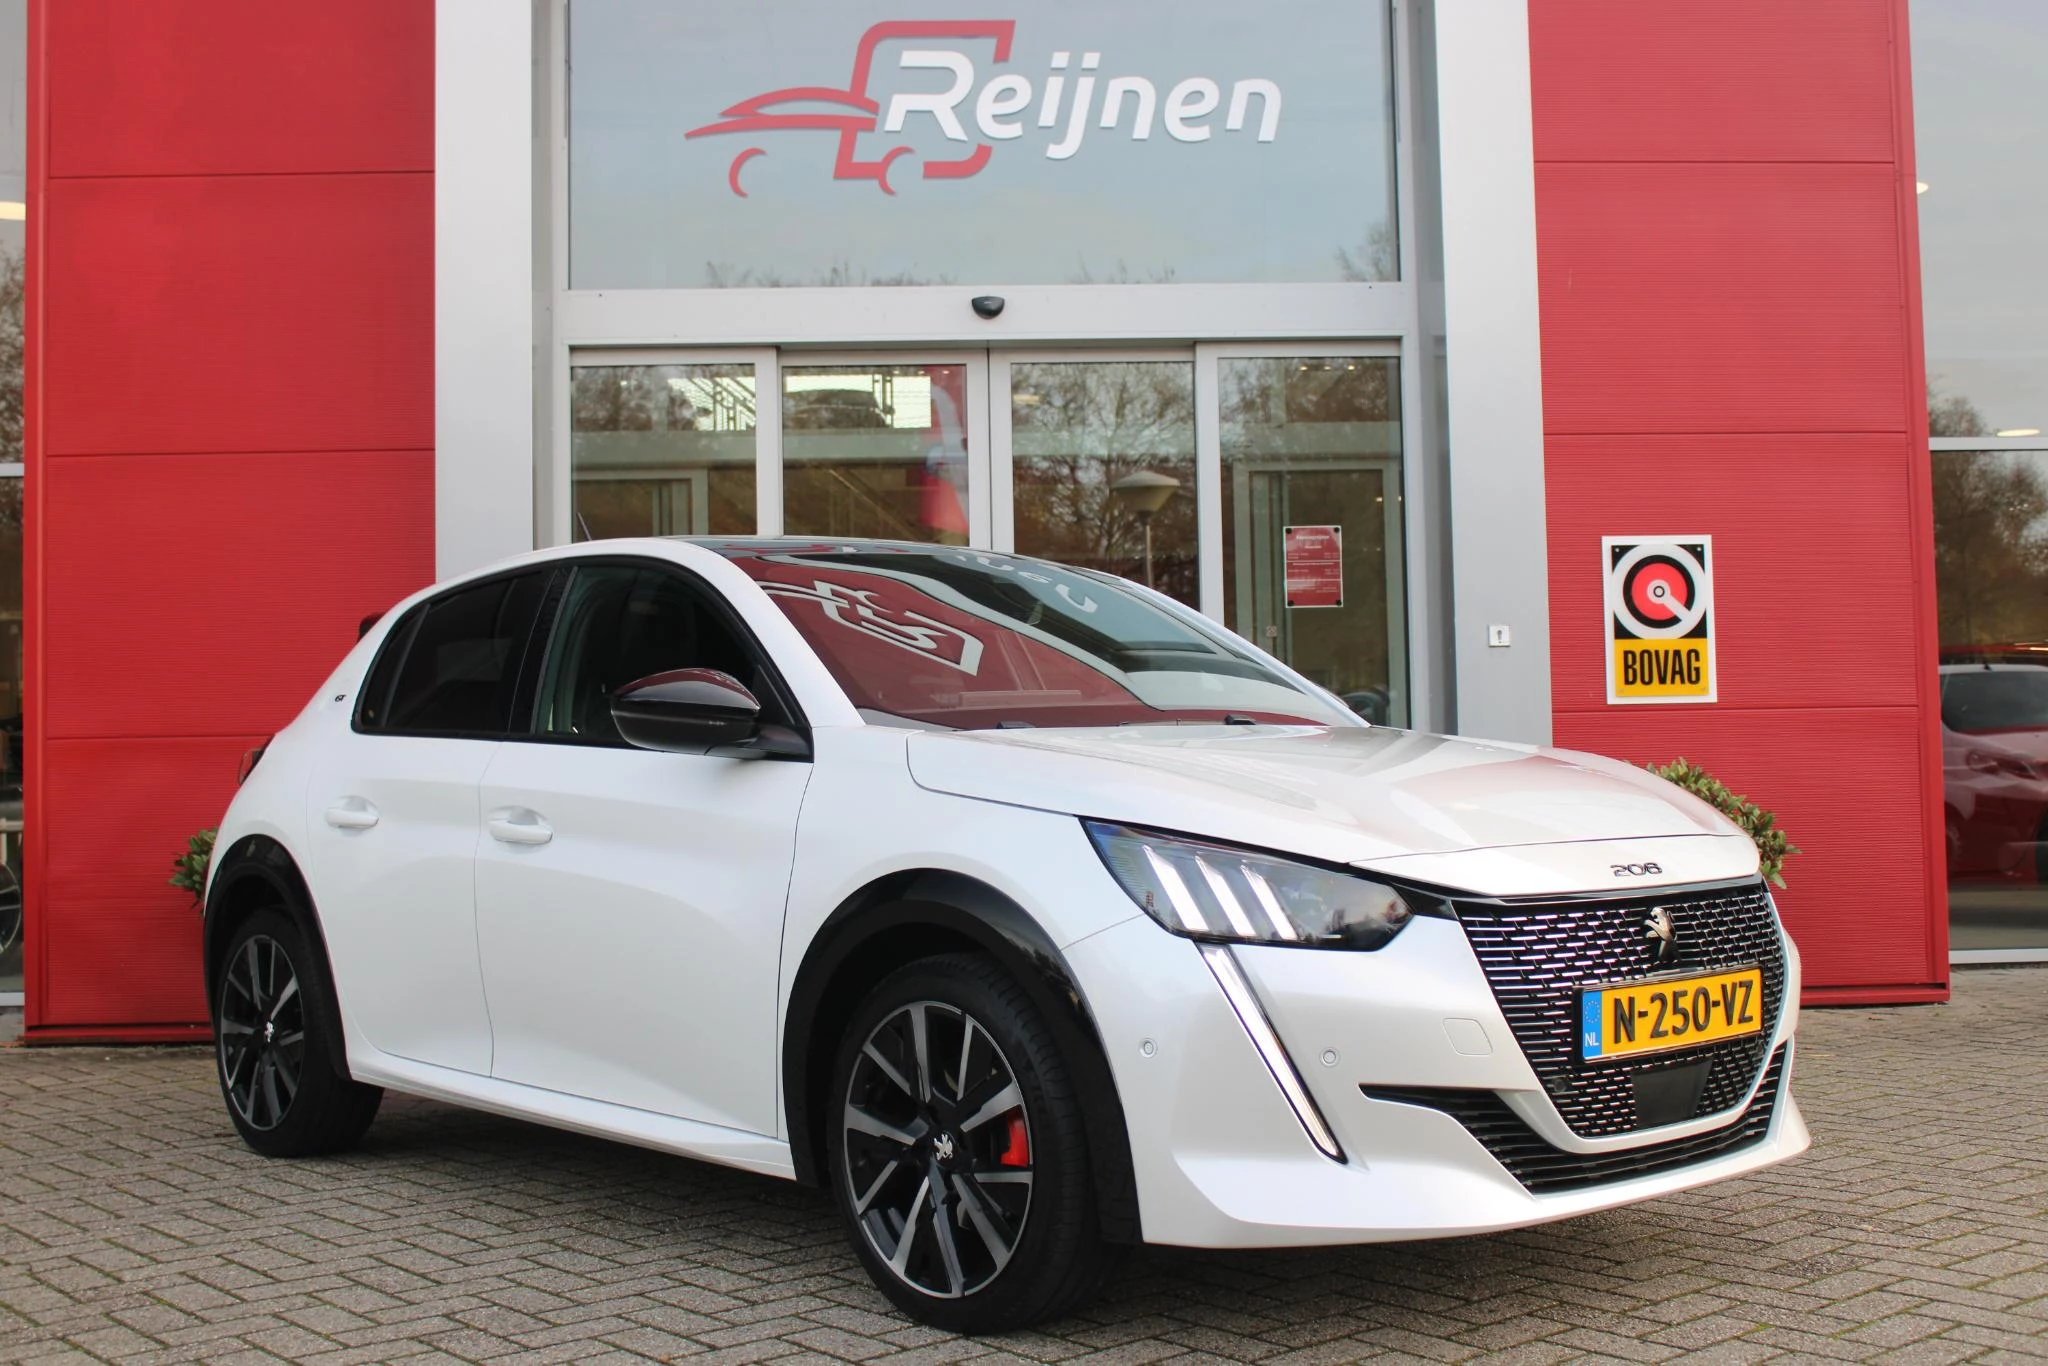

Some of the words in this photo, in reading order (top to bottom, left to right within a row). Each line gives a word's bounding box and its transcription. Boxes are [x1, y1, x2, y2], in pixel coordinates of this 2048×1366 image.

[884, 50, 1282, 160] Reijnen
[1623, 648, 1701, 685] BOVAG
[1614, 979, 1754, 1045] N-250-VZ
[1585, 1031, 1600, 1047] NL
